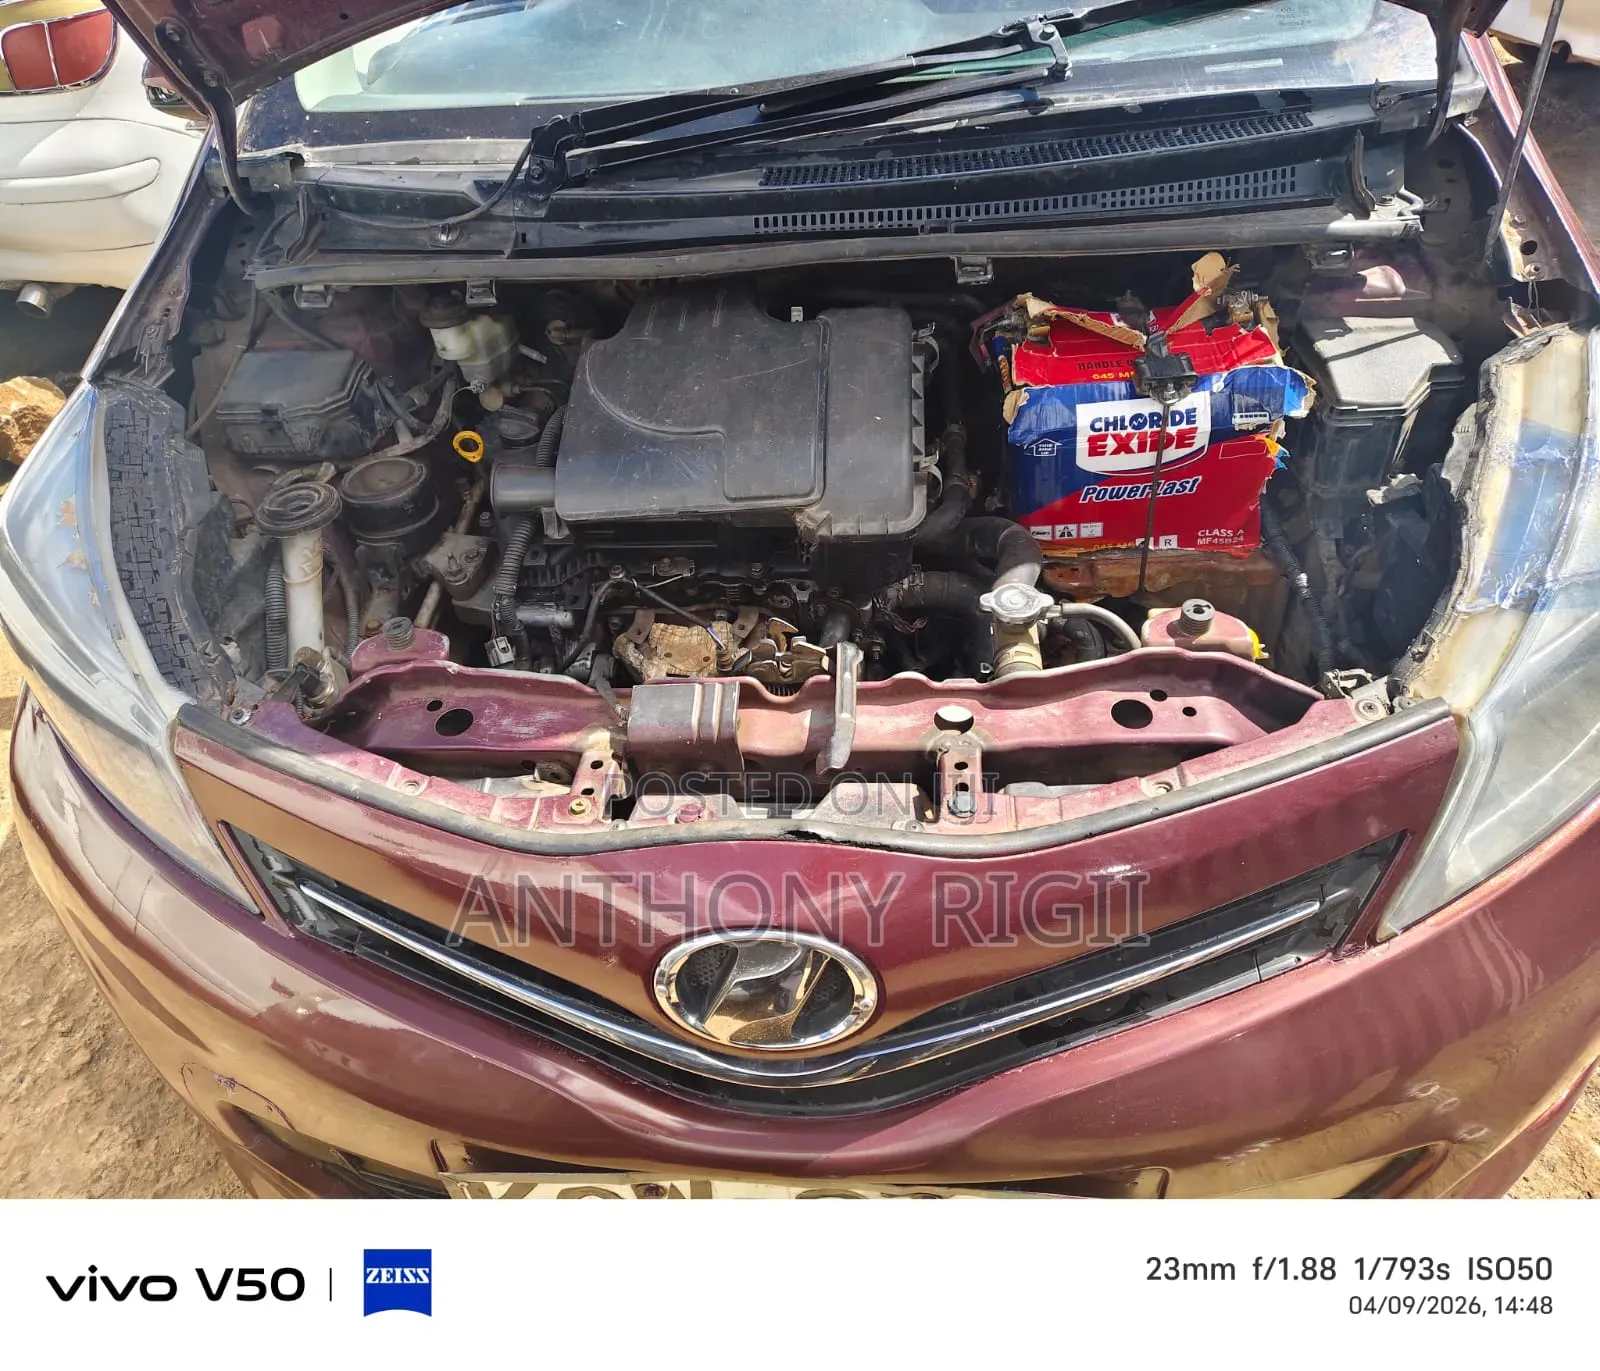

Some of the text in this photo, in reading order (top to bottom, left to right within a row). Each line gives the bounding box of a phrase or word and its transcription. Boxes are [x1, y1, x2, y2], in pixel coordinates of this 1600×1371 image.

[1089, 407, 1197, 432] CHLORDE
[1087, 427, 1198, 457] EXIDE
[1197, 528, 1234, 537] CLASS
